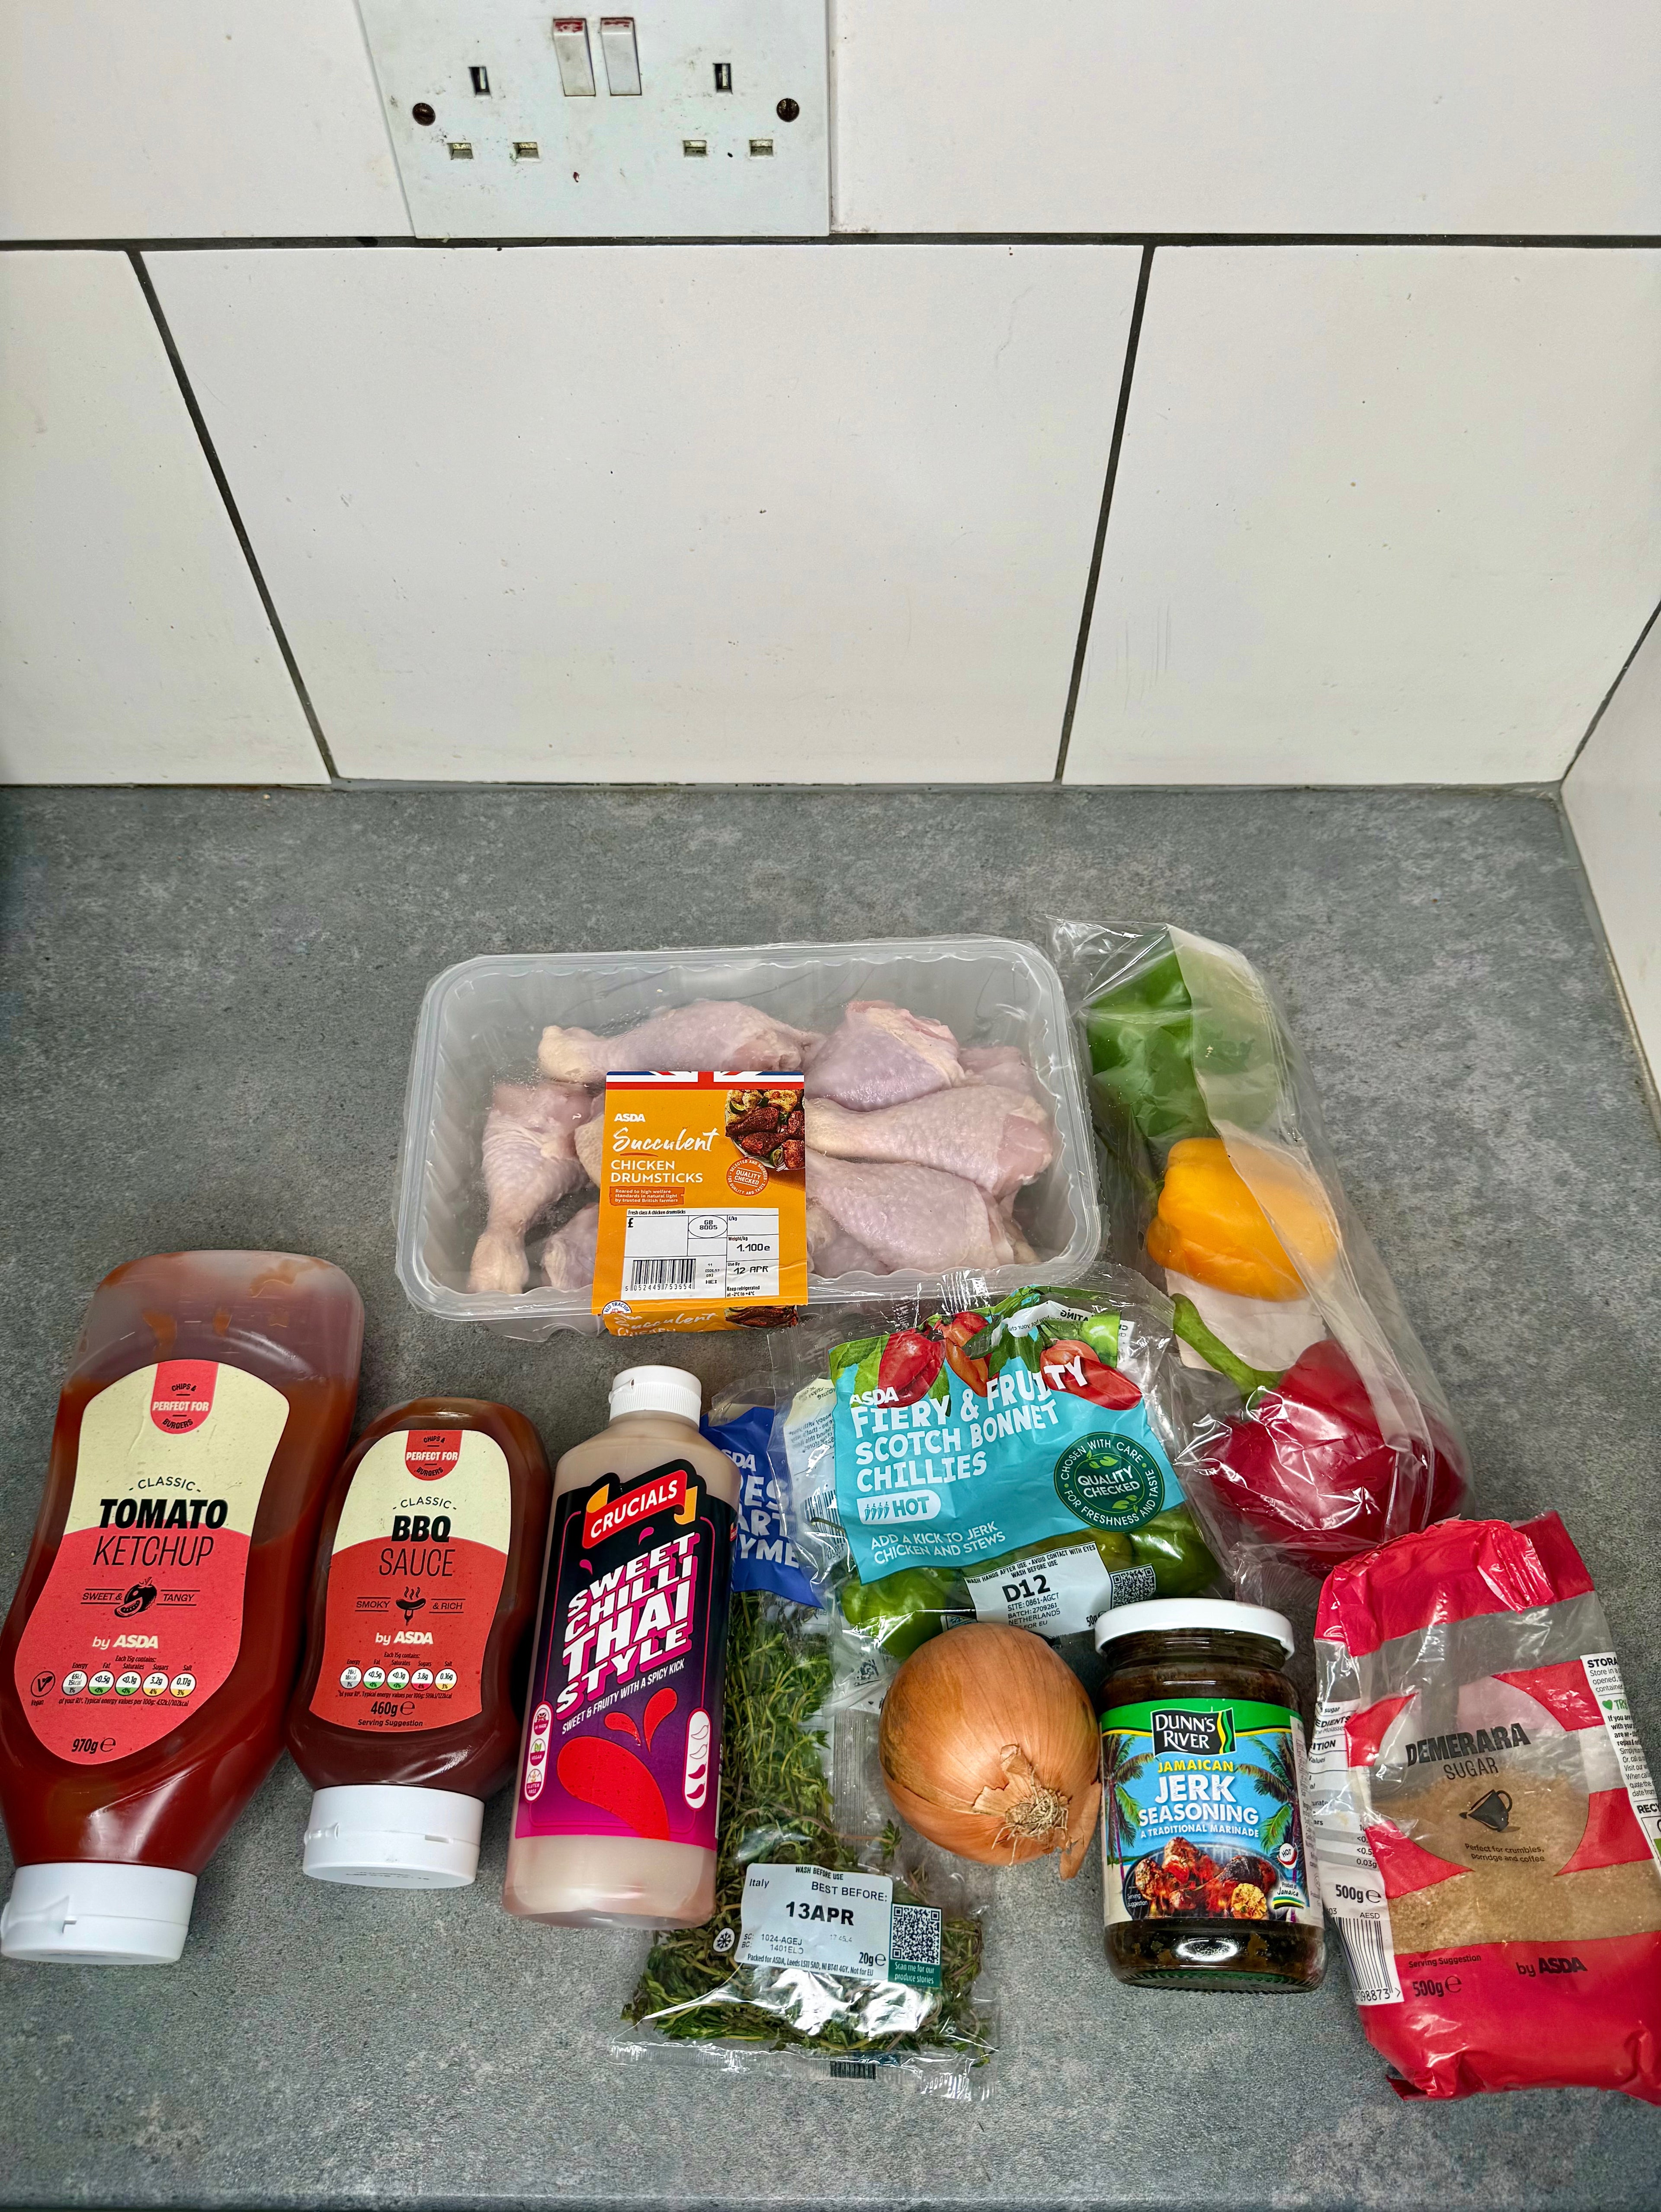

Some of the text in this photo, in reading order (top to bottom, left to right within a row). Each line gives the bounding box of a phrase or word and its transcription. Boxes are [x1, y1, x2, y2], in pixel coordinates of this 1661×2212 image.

[614, 1114, 645, 1122] ASDA
[612, 1127, 720, 1152] Succulent
[611, 1160, 675, 1170] CHICKEN
[611, 1172, 703, 1183] DRUMSTICKS
[734, 1176, 759, 1185] CHECKED
[736, 1170, 761, 1179] QUALITY
[628, 1218, 633, 1228] £
[612, 1302, 630, 1312] TRACTOR
[849, 1387, 899, 1405] ASDA
[850, 1395, 950, 1438] FIERY
[960, 1389, 979, 1422] &
[986, 1355, 1088, 1412] FRUITY
[152, 1401, 209, 1411] PERFECT FOR
[163, 1418, 193, 1429] BURGERS
[855, 1428, 962, 1465] SCOTCH
[970, 1399, 1058, 1449] BONNET
[406, 1452, 458, 1460] PERFECT FOR
[1061, 1439, 1143, 1480] CHOSEN WITH CARE
[417, 1467, 443, 1476] BURGERS
[857, 1451, 986, 1492] CHILLIES
[1077, 1465, 1133, 1485] QUALITY
[138, 1476, 196, 1491] CLASSIC
[1084, 1481, 1140, 1498] CHECKED
[401, 1496, 452, 1509] CLASSIC
[1064, 1469, 1158, 1526] FOR FRESHNESS AND TASTE
[99, 1498, 228, 1529] TOMATO
[590, 1479, 678, 1538] CRUCIALS
[892, 1496, 930, 1517] HOT
[391, 1515, 451, 1543] BBQ
[871, 1521, 998, 1550] ADD A KICK TO JERK
[93, 1536, 214, 1566] KETCHUP
[874, 1531, 1006, 1564] CHICKEN AND STEWS
[379, 1548, 455, 1576] SAUCE
[982, 1572, 998, 1582] HANDS
[1000, 1565, 1016, 1575] AFTER
[1017, 1562, 1027, 1571] USE
[1032, 1556, 1045, 1565] AVOID
[1046, 1550, 1068, 1560] CONTACT
[567, 1532, 695, 1618] SWEET
[1011, 1569, 1026, 1578] WASH
[1027, 1564, 1047, 1573] BEFORE
[1002, 1575, 1051, 1602] D12
[564, 1555, 692, 1643] CHILLI
[1007, 1602, 1024, 1611] SITE:
[1008, 1603, 1057, 1619] BATCH: 2709261
[375, 1631, 433, 1645] by ASDA
[563, 1580, 691, 1682] THAI
[92, 1635, 159, 1650] by ASDA
[556, 1622, 688, 1714] STYLE
[150, 1677, 163, 1685] 3.2g
[176, 1677, 192, 1686] 0.17g
[562, 1658, 684, 1735] SWEET FRUITY WITH A SPICY KICK
[371, 1701, 398, 1717] 460g
[1155, 1714, 1215, 1732] DUNN'S
[71, 1738, 99, 1754] 970g
[1164, 1730, 1210, 1751] RIVER
[1405, 1723, 1531, 1767] DEMERARA
[1158, 1760, 1233, 1773] JAMAICAN
[1443, 1757, 1499, 1780] SUGAR
[1155, 1774, 1236, 1803] JERK
[1138, 1803, 1259, 1826] SEASONING
[1141, 1825, 1259, 1838] A TRADITIONAL MARINADE
[1281, 1849, 1291, 1857] HOT
[1465, 1843, 1491, 1852] Perfect
[1356, 1859, 1377, 1868] 0.03g
[1471, 1853, 1503, 1862] porridge
[795, 1866, 811, 1874] WASH
[813, 1867, 831, 1879] BEFORE
[749, 1879, 769, 1888] Italy
[811, 1881, 887, 1902] BEST BEFORE:
[1277, 1887, 1299, 1896] Jamaica
[1336, 1884, 1363, 1903] 500g
[786, 1901, 854, 1926] 13APR
[747, 1953, 764, 1962] Packed
[772, 1958, 786, 1966] ASDA,
[859, 1952, 874, 1966] 20g
[895, 1962, 907, 1970] Scan
[1408, 1954, 1481, 1969] Serving Suggestion
[1517, 1957, 1588, 1977] by ASDA
[895, 1973, 933, 1984] produce stories
[1412, 1979, 1444, 1998] 500g
